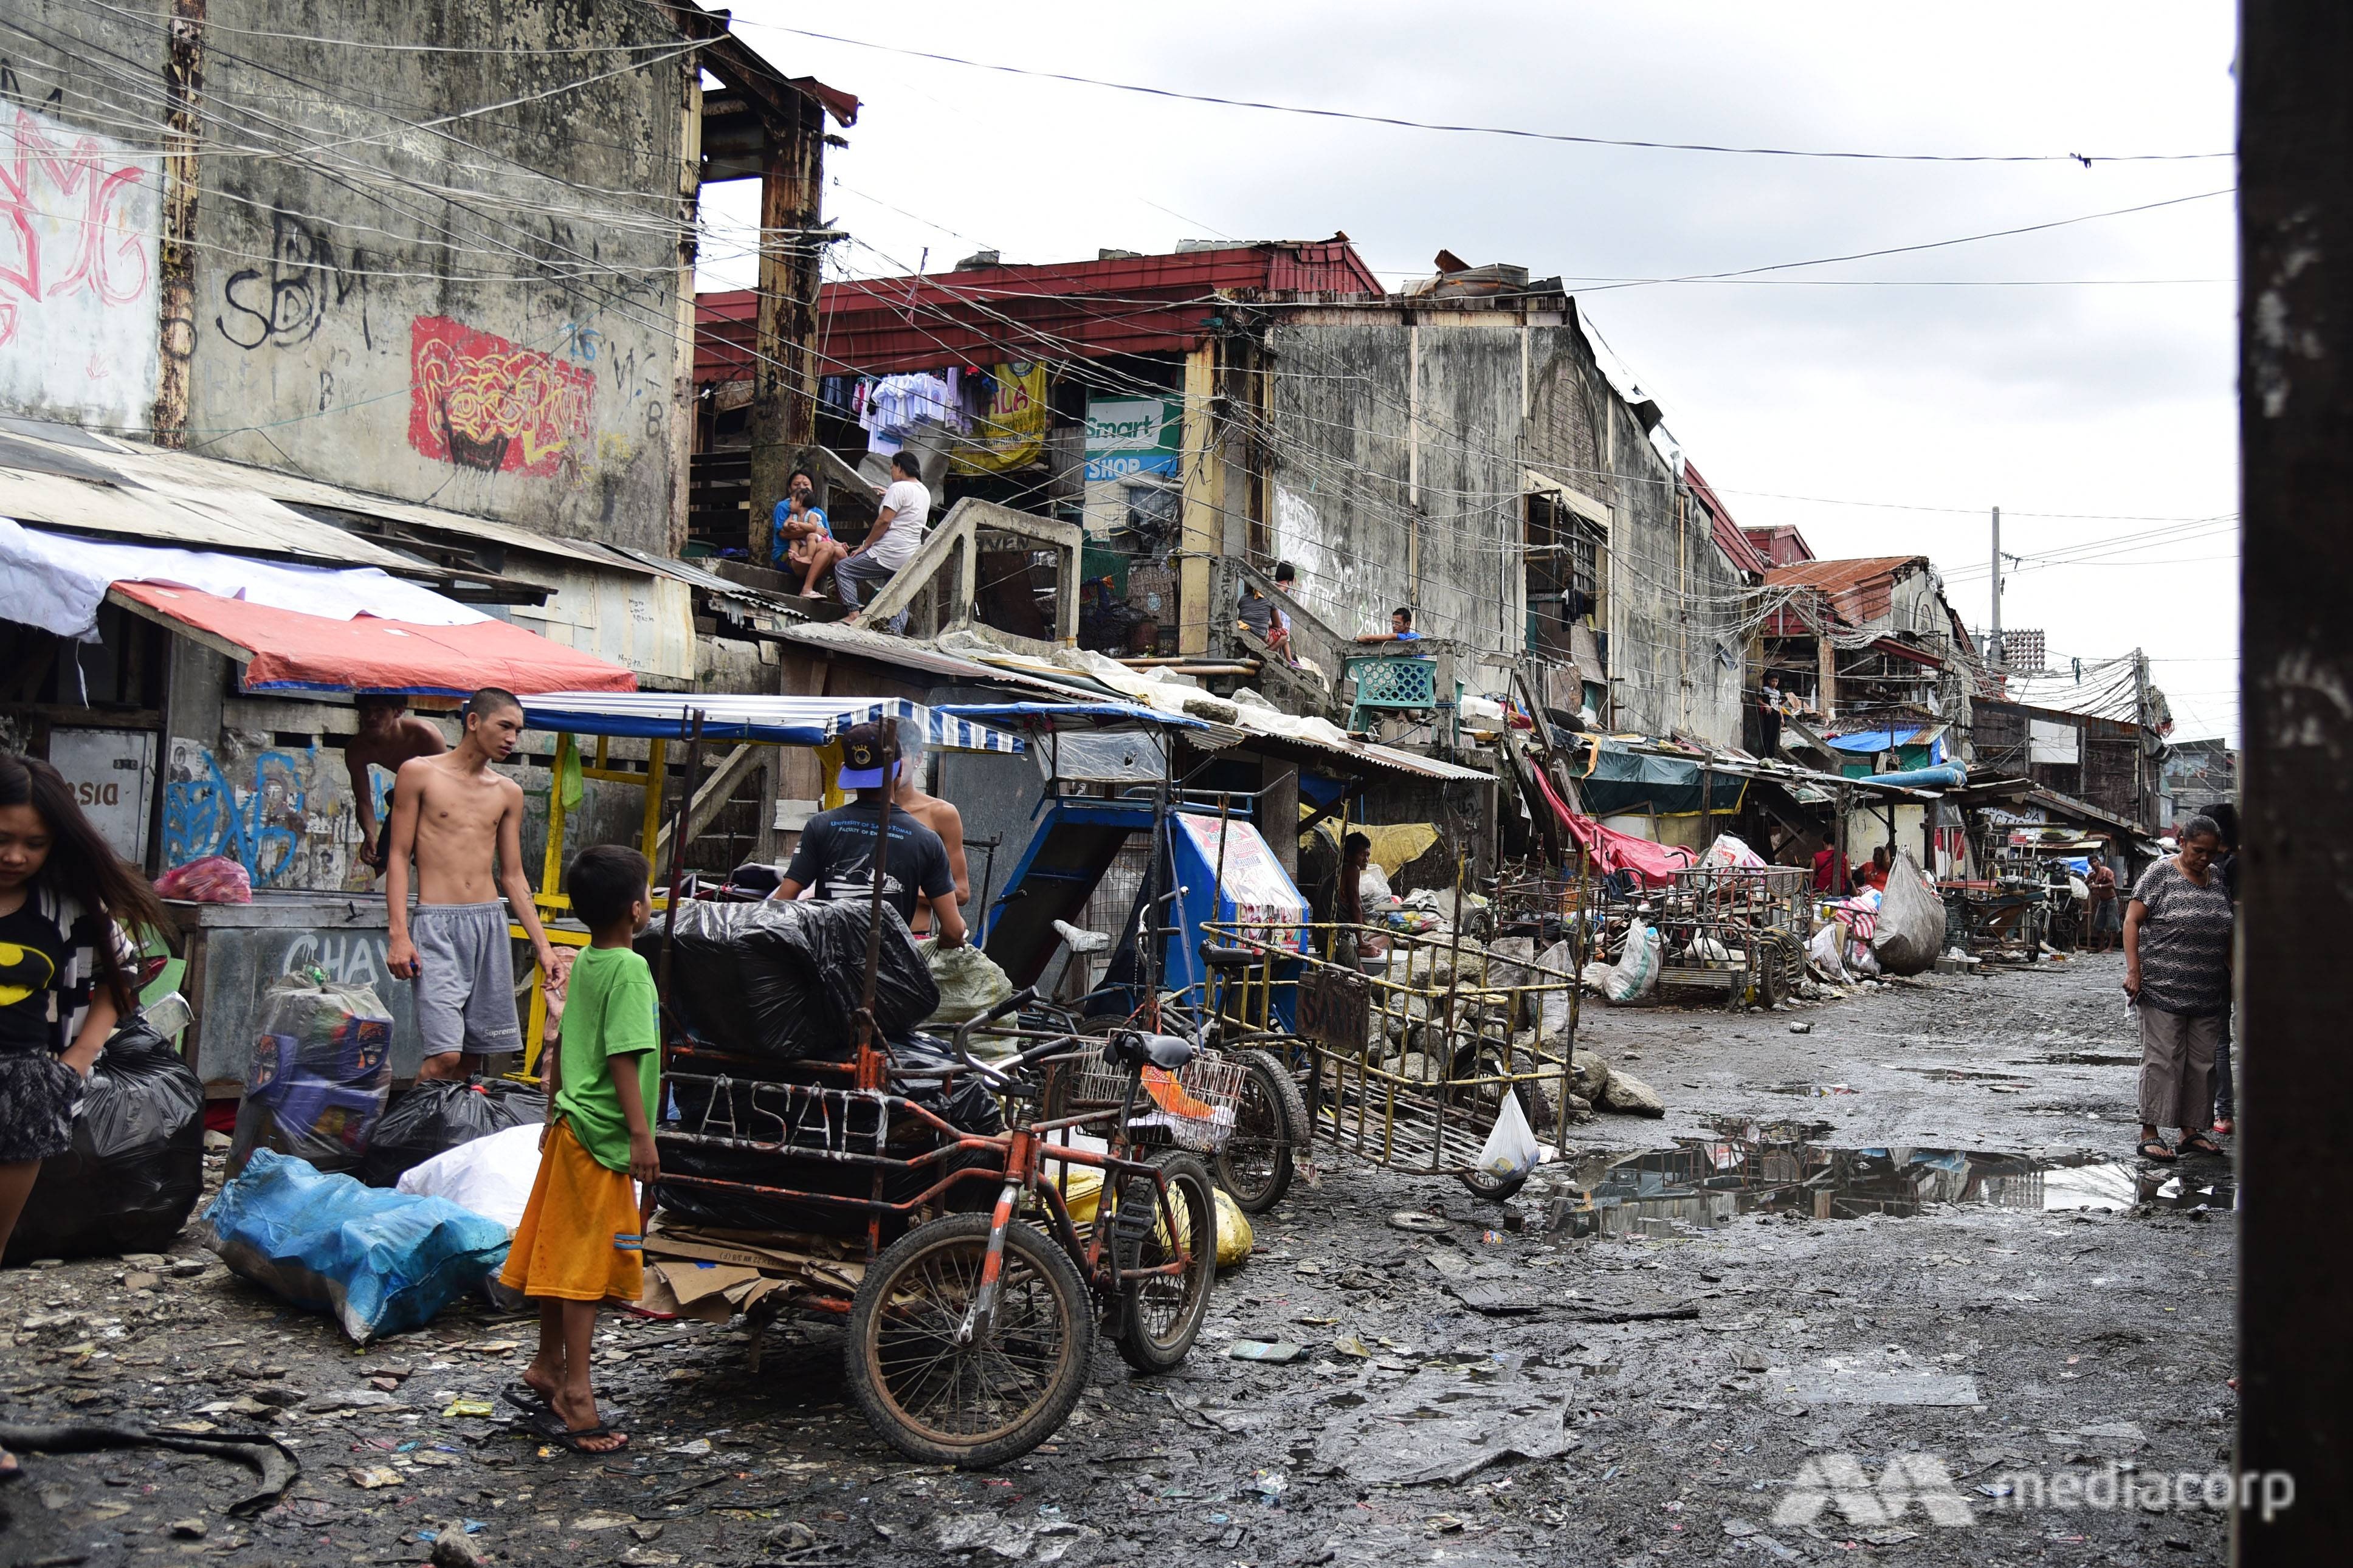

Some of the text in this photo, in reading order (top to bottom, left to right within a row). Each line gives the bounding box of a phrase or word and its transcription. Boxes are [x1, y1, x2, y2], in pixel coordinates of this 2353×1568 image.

[1087, 415, 1152, 438] Smart
[1089, 459, 1140, 478] SHOP
[698, 1073, 887, 1162] ASAP
